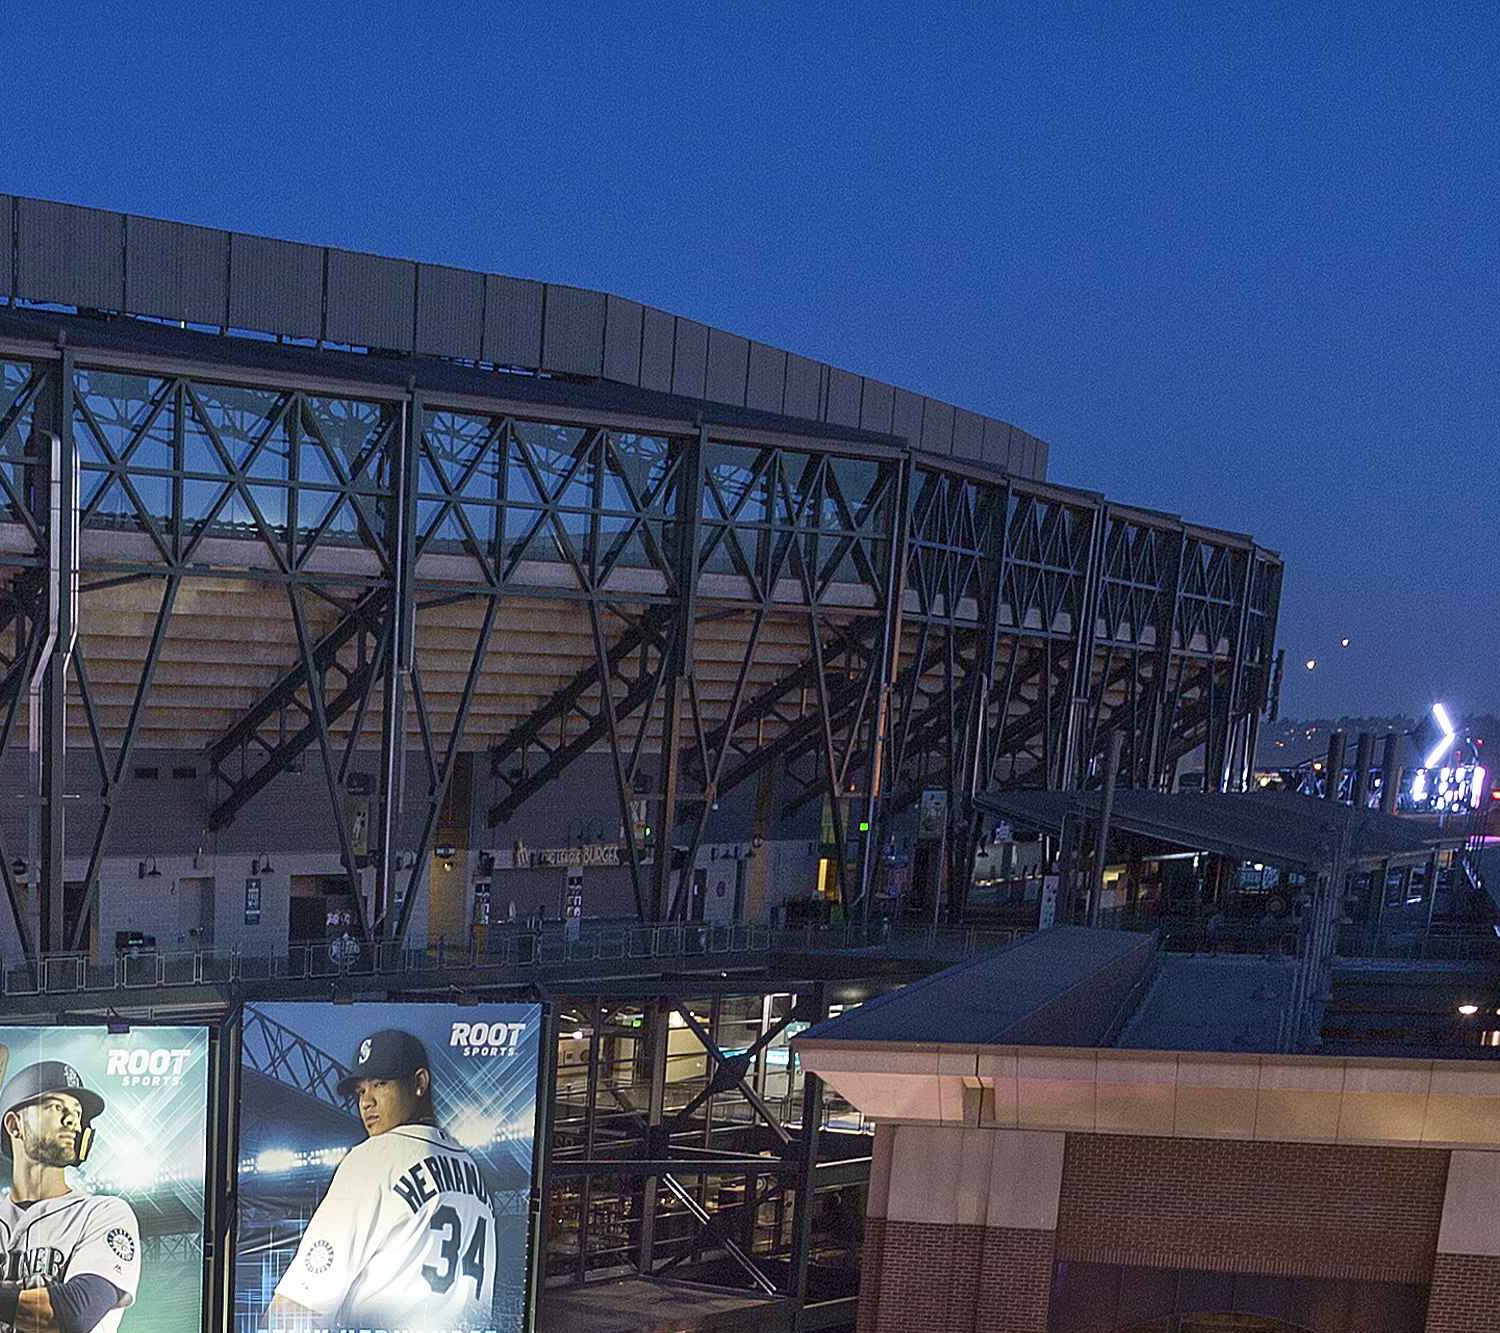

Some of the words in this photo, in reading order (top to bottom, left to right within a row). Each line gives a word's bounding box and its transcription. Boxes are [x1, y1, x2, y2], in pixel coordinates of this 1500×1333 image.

[450, 1022, 526, 1047] ROOT
[106, 1048, 192, 1076] ROOT
[463, 1046, 517, 1057] SPORTS
[121, 1075, 181, 1087] SPORTS
[393, 1155, 495, 1218] HERNAND
[421, 1204, 488, 1301] 34
